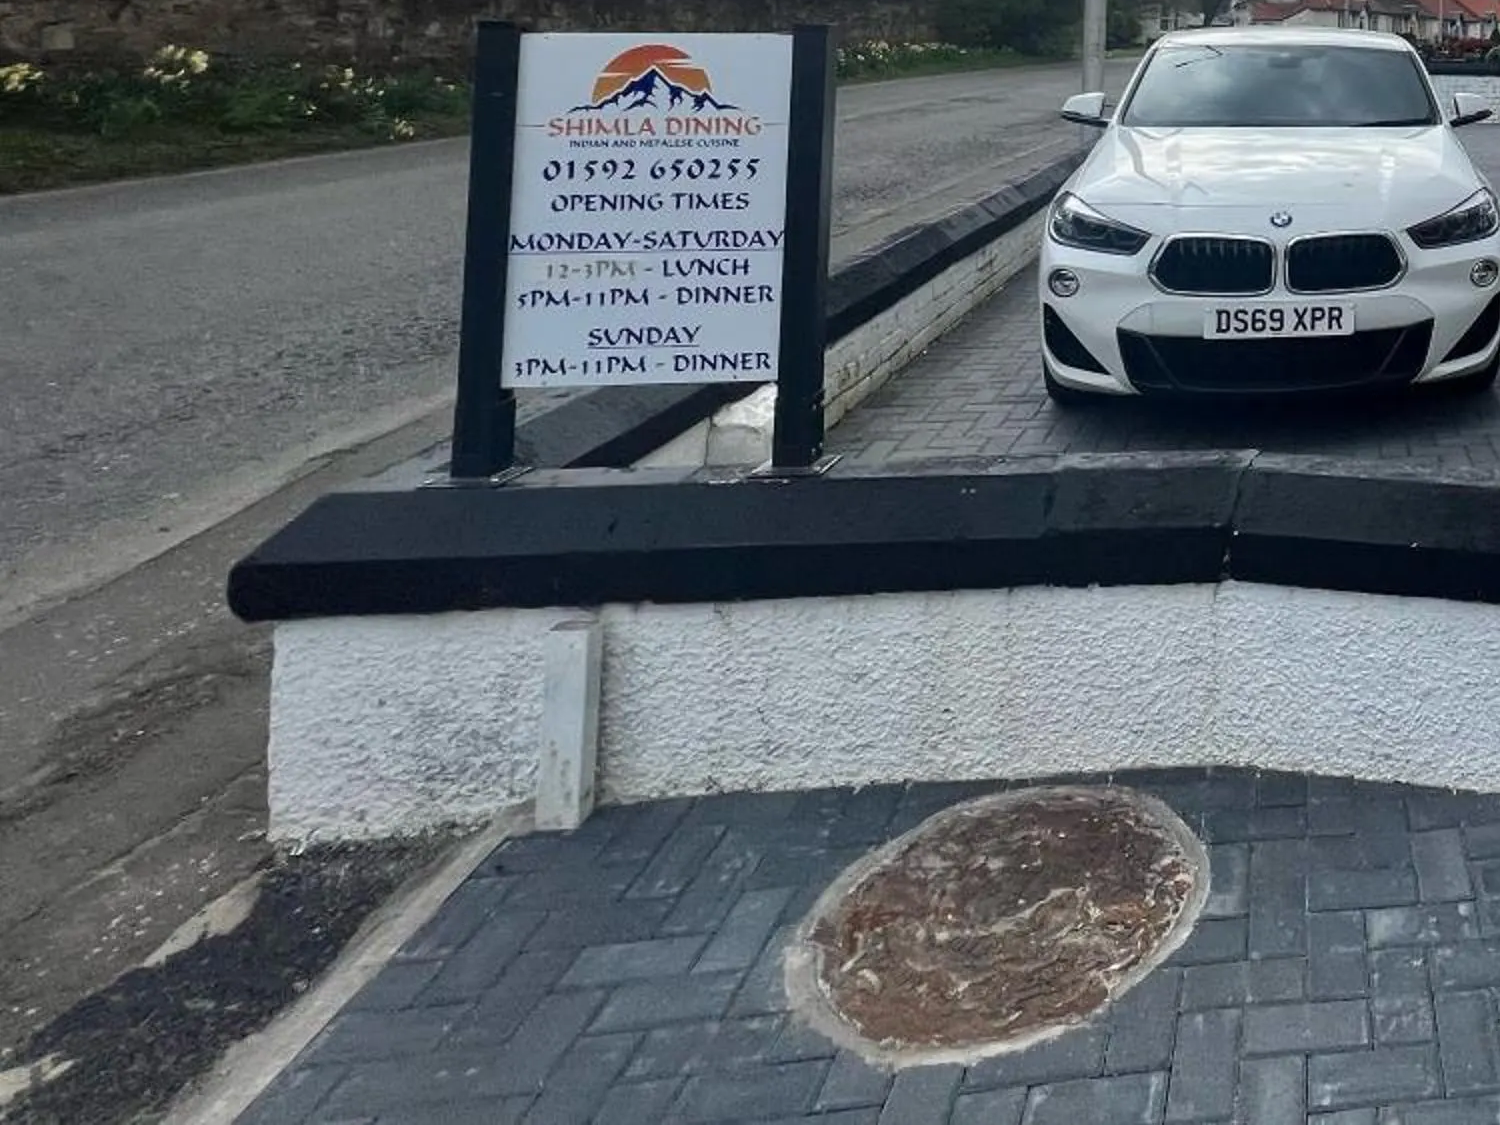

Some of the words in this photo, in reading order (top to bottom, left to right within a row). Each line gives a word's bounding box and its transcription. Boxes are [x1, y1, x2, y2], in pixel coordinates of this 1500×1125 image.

[548, 117, 656, 137] SHIMLA
[664, 117, 762, 136] DINING
[569, 139, 609, 148] INDIAN
[612, 139, 637, 148] AND
[639, 139, 694, 148] NEPALESE
[697, 138, 740, 147] CUISINE
[543, 159, 636, 182] 01592
[650, 158, 760, 181] 650255
[551, 192, 664, 212] OPENING
[670, 192, 750, 210] TIMES
[547, 260, 637, 279] 12-3PM
[663, 258, 750, 277] LUNCH
[518, 288, 650, 309] 5PM-11PM
[677, 285, 775, 305] DINNER
[1216, 308, 1285, 333] DS69
[1293, 306, 1343, 331] XPR
[588, 325, 702, 347] SUNDAY
[515, 356, 648, 377] 3PM-11PM
[673, 352, 771, 373] DINNER
